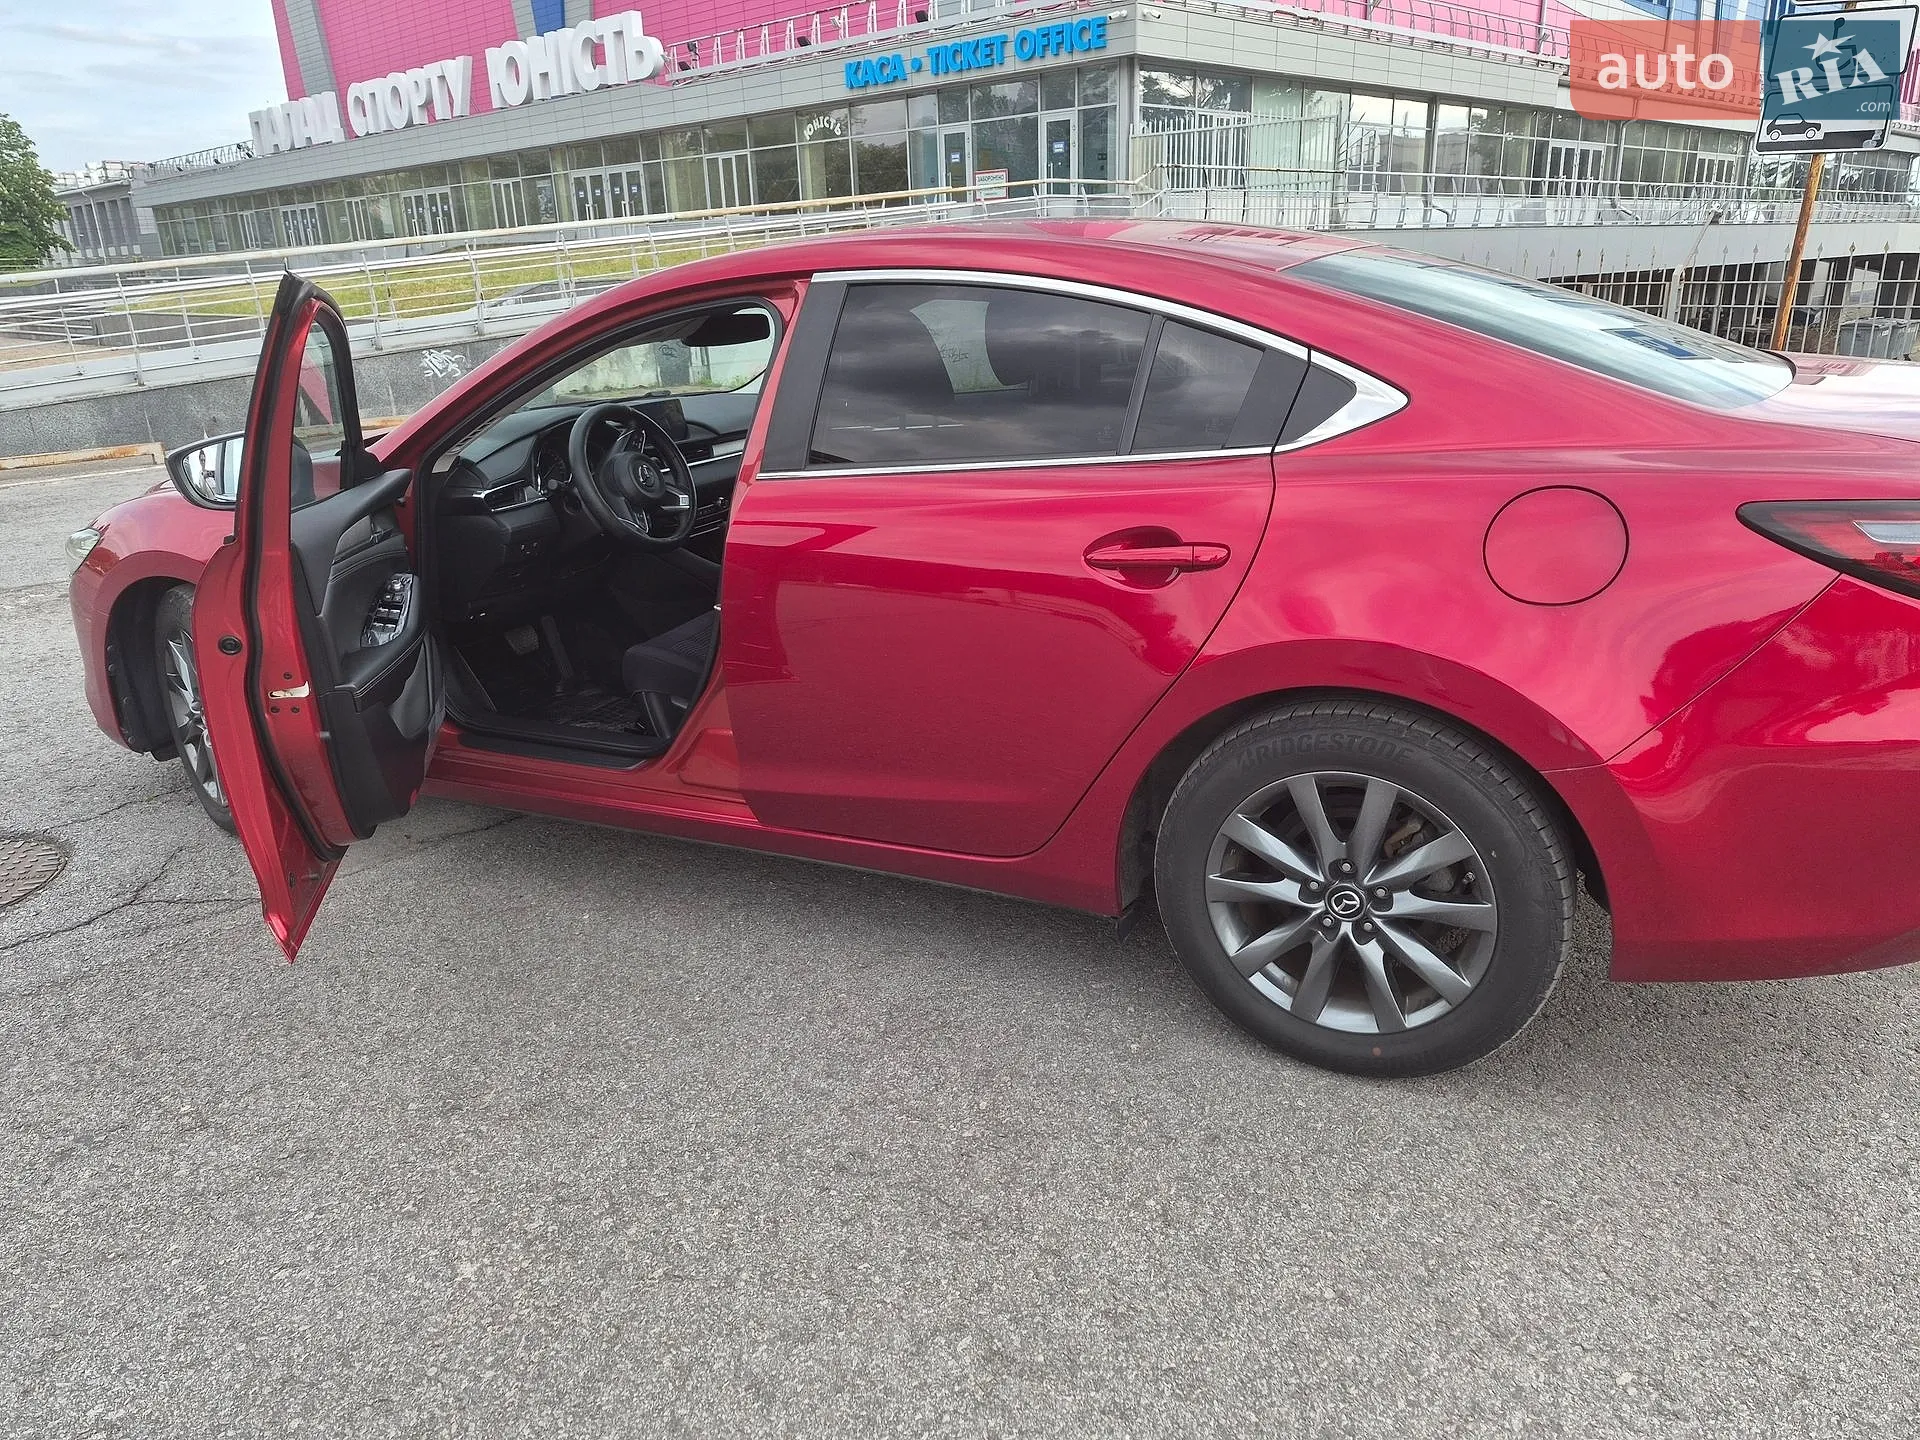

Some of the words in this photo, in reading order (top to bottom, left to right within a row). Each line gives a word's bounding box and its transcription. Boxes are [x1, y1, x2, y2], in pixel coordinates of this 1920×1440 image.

[248, 91, 345, 157] ПАЛАЦ
[347, 55, 472, 137] СПОРТУ
[485, 10, 665, 108] ЮНІСТЬ
[845, 55, 907, 89] КАСА
[927, 35, 1008, 76] TICKET
[1014, 16, 1108, 62] OFFICE
[803, 115, 842, 141] ЮНІСТЬ
